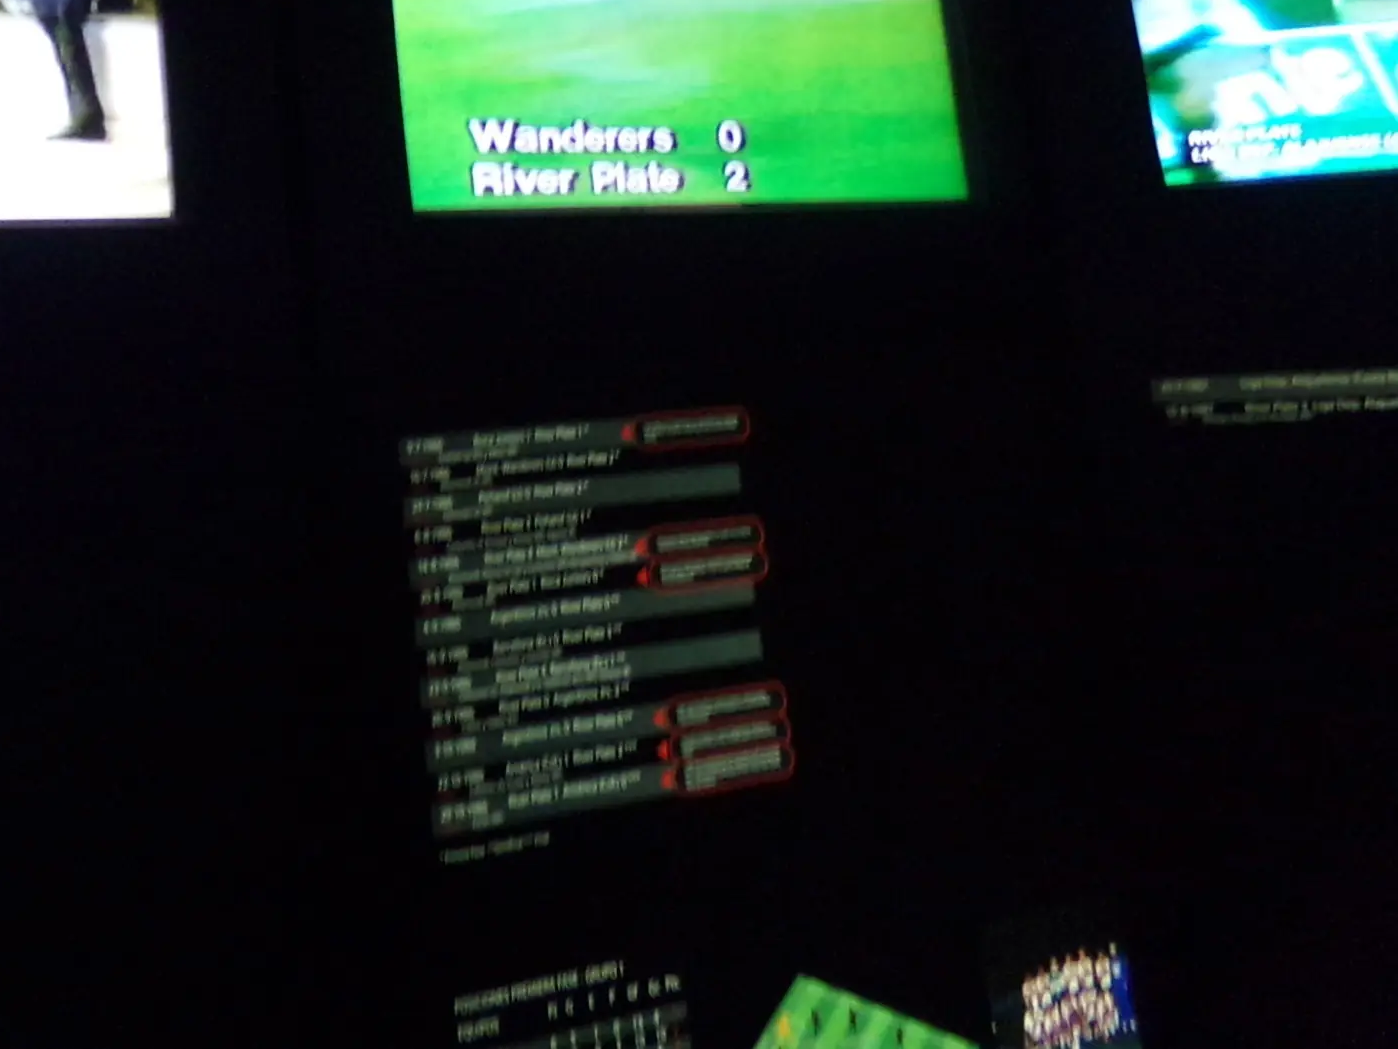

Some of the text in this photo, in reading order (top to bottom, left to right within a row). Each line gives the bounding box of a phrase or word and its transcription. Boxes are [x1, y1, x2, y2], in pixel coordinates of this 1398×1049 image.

[468, 118, 744, 154] Wanderers 0
[471, 160, 750, 197] River Plate 2
